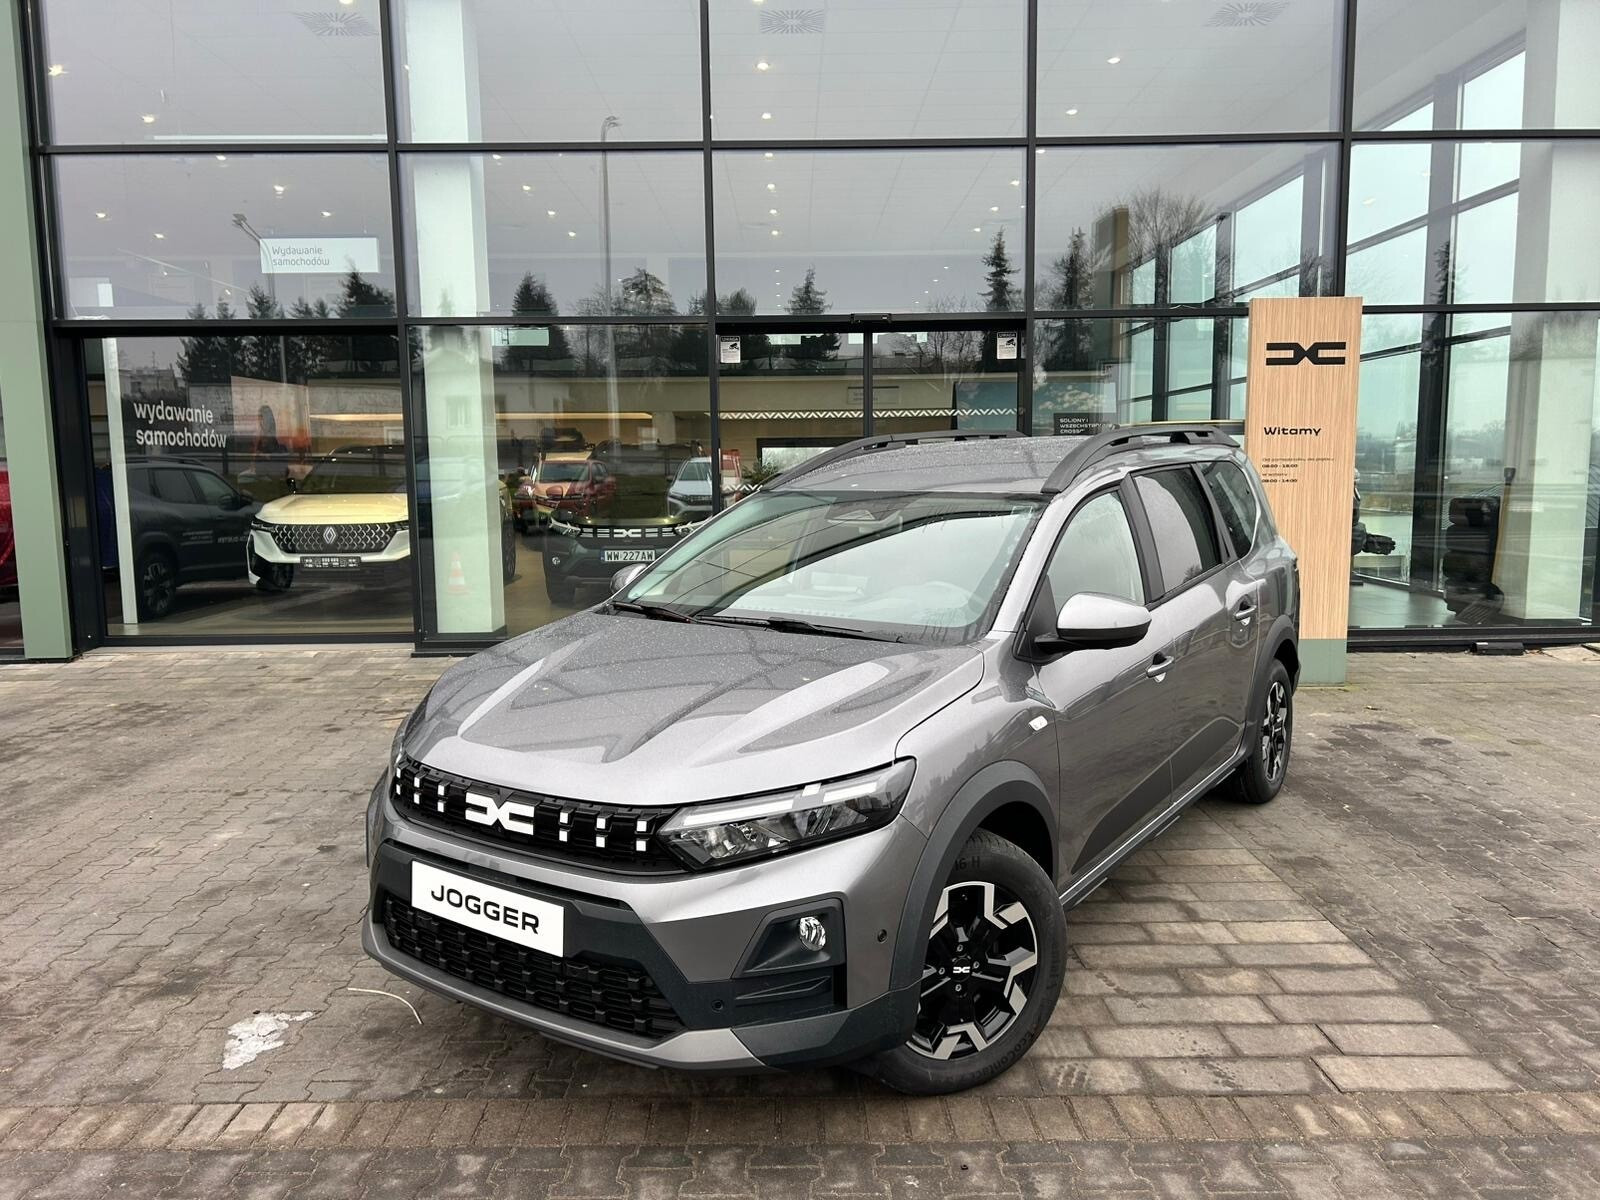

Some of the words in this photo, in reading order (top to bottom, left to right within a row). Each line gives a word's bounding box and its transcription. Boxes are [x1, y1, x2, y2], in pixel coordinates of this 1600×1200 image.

[272, 246, 323, 256] Wydawanie
[272, 256, 330, 266] samochodów
[133, 400, 214, 424] wydawanie
[1263, 426, 1322, 436] Witamy
[136, 427, 227, 448] samochodów
[623, 551, 654, 561] 227AW
[431, 885, 539, 934] JOGGER
